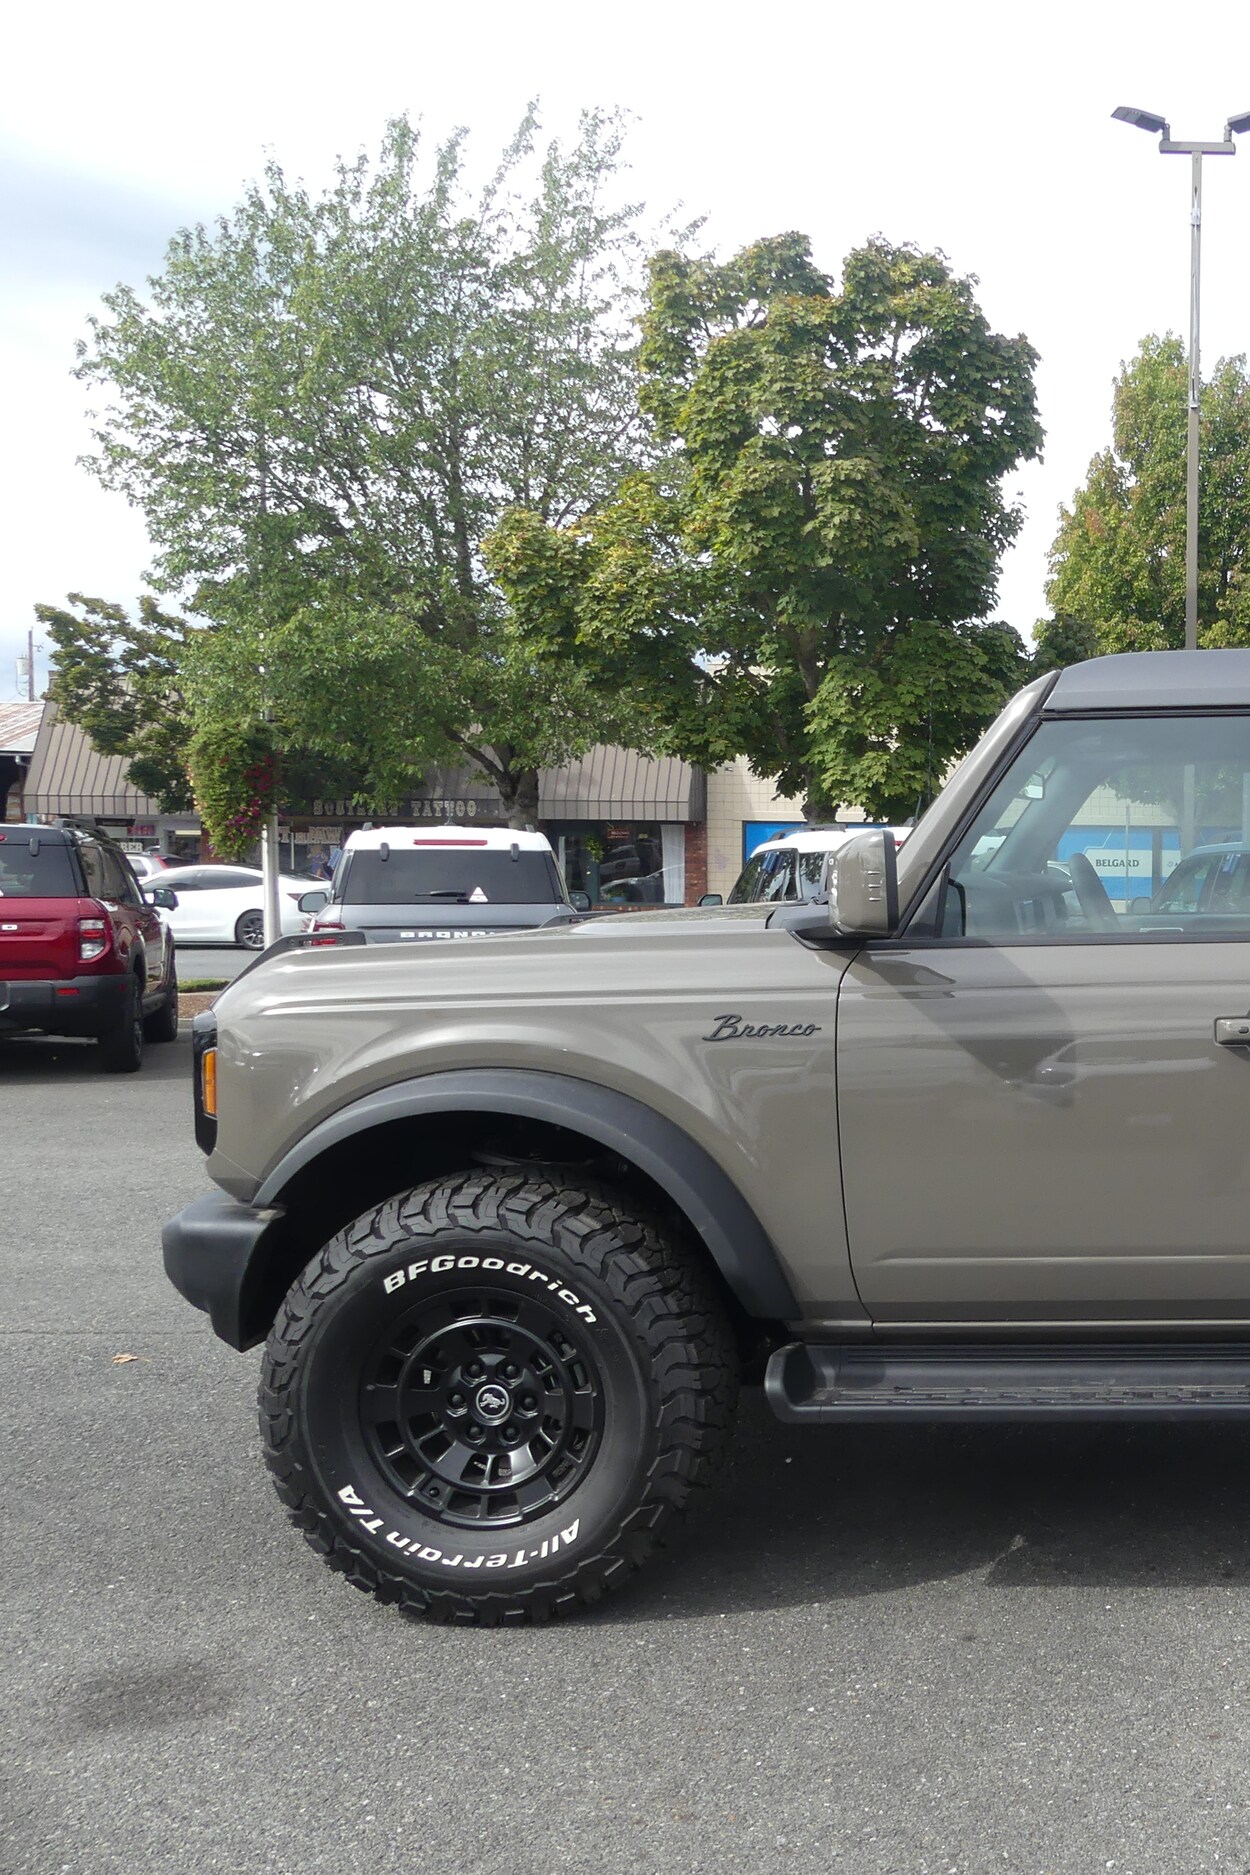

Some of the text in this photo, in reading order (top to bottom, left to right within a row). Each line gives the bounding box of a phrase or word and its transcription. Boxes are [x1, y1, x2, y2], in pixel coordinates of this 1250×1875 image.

[411, 800, 477, 816] TATTOO
[1095, 858, 1139, 868] BELGARD
[702, 1014, 822, 1041] Bronco
[383, 1254, 599, 1324] BFGoodrich
[337, 1484, 581, 1570] All-Terrain T/A
